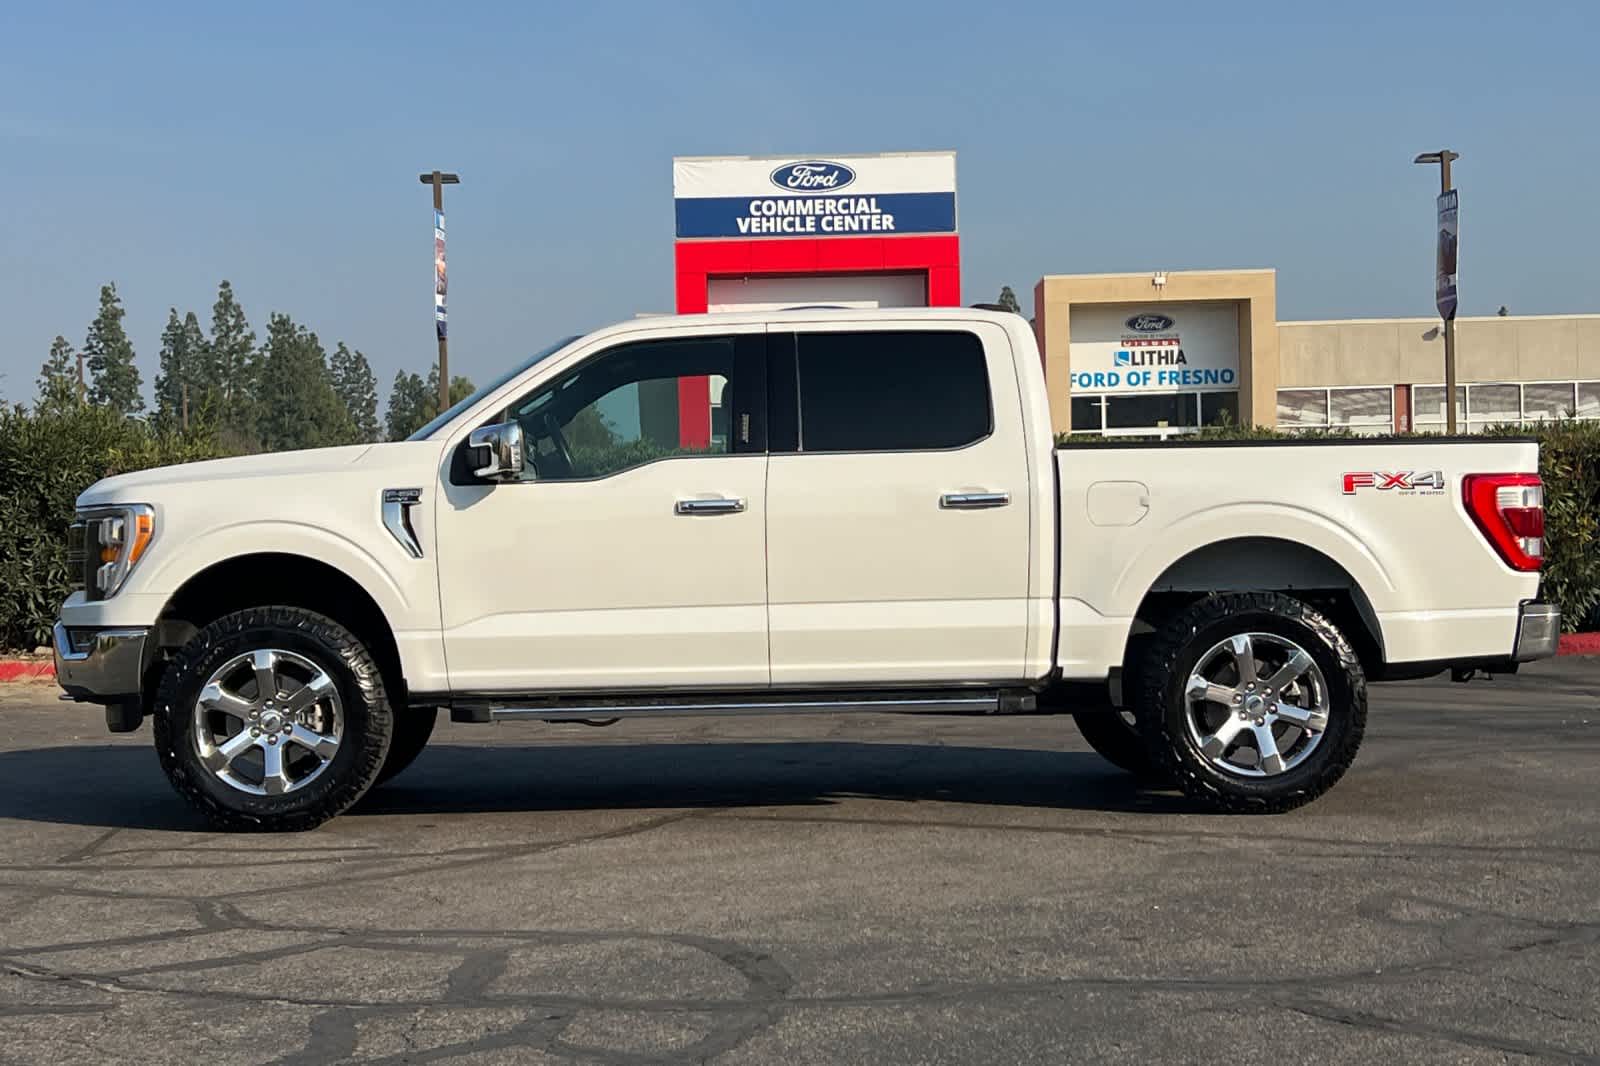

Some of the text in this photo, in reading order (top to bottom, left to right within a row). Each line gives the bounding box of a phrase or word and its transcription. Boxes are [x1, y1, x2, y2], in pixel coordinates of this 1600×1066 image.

[787, 165, 838, 187] Ford
[749, 198, 881, 216] COMMERCIAL
[736, 214, 895, 233] VEHICLE CENTER
[1134, 316, 1165, 330] Ford
[1131, 350, 1187, 366] LITHIA
[1126, 371, 1151, 386] OF
[1158, 368, 1235, 385] FRESNO
[1342, 471, 1444, 495] FX4
